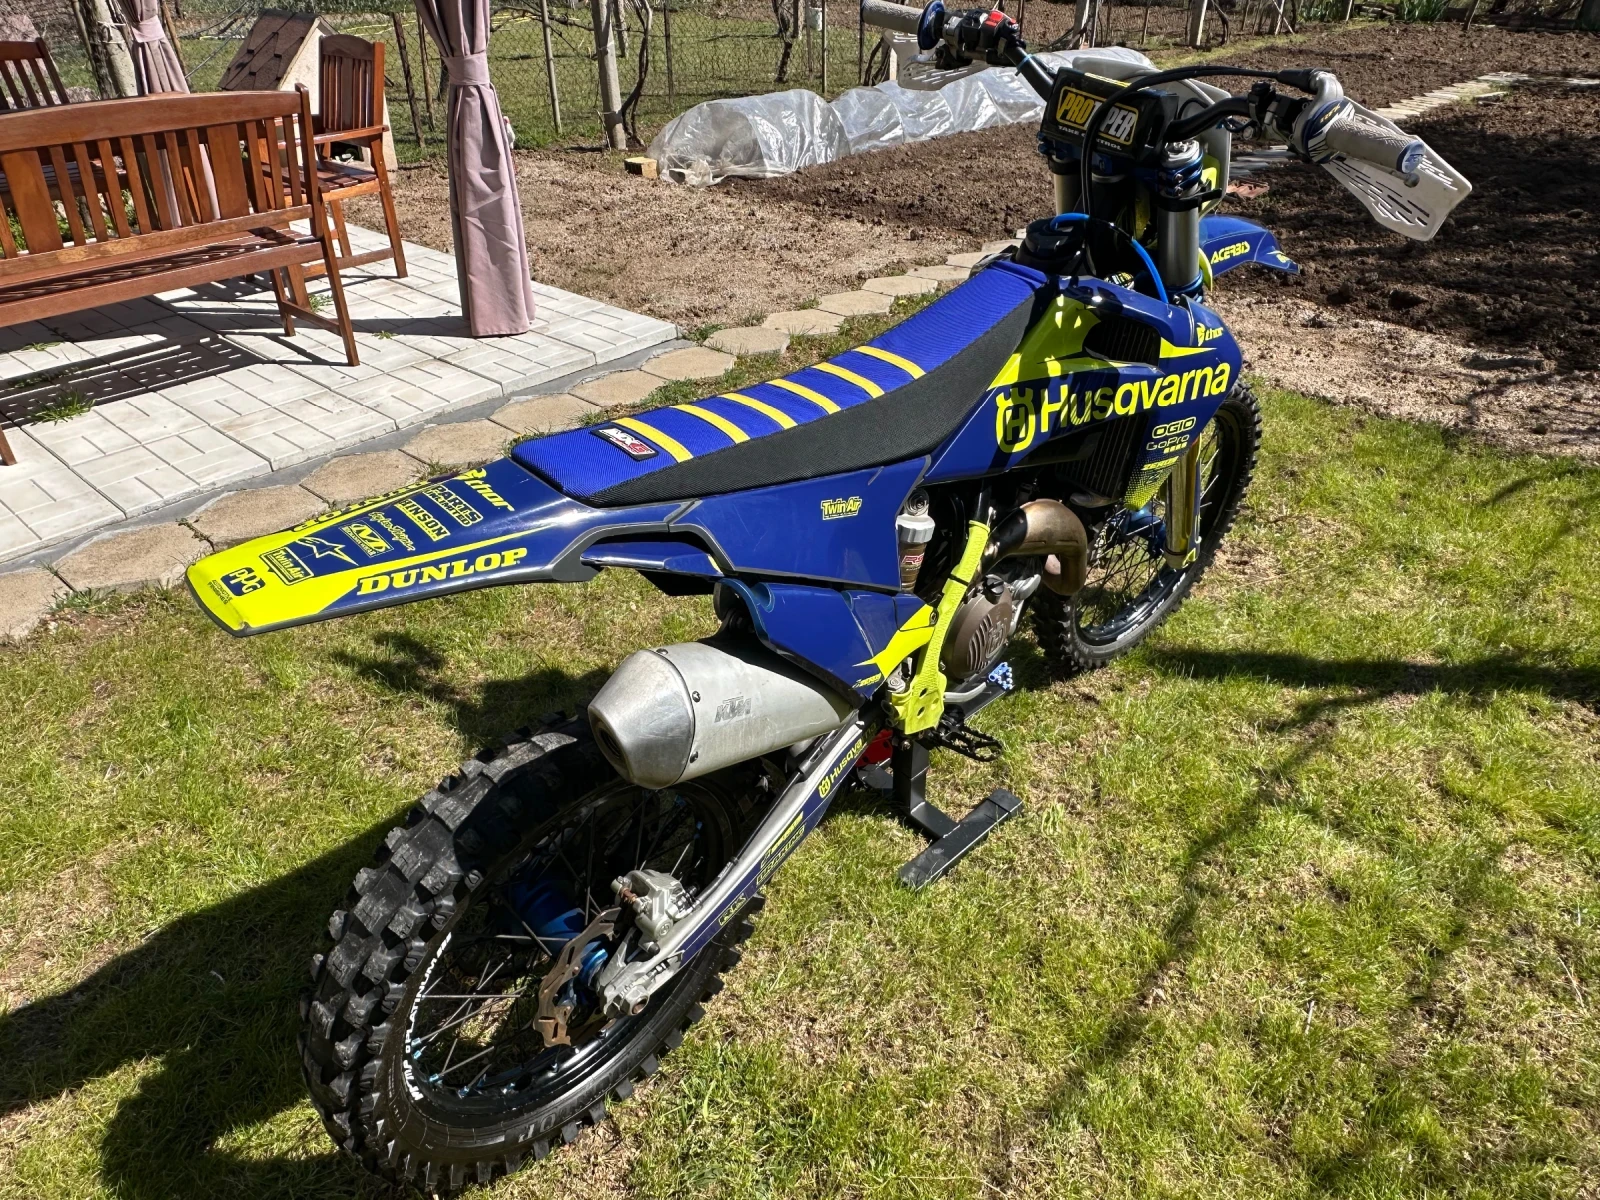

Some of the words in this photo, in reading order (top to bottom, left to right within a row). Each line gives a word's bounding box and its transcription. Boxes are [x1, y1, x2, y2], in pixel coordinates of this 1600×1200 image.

[1211, 241, 1251, 265] ACERBIS
[1040, 362, 1231, 433] Husqvarna
[1153, 417, 1196, 438] OGIO
[1146, 434, 1190, 450] GoPro
[357, 547, 528, 596] DUNLOP
[714, 696, 752, 723] KTM
